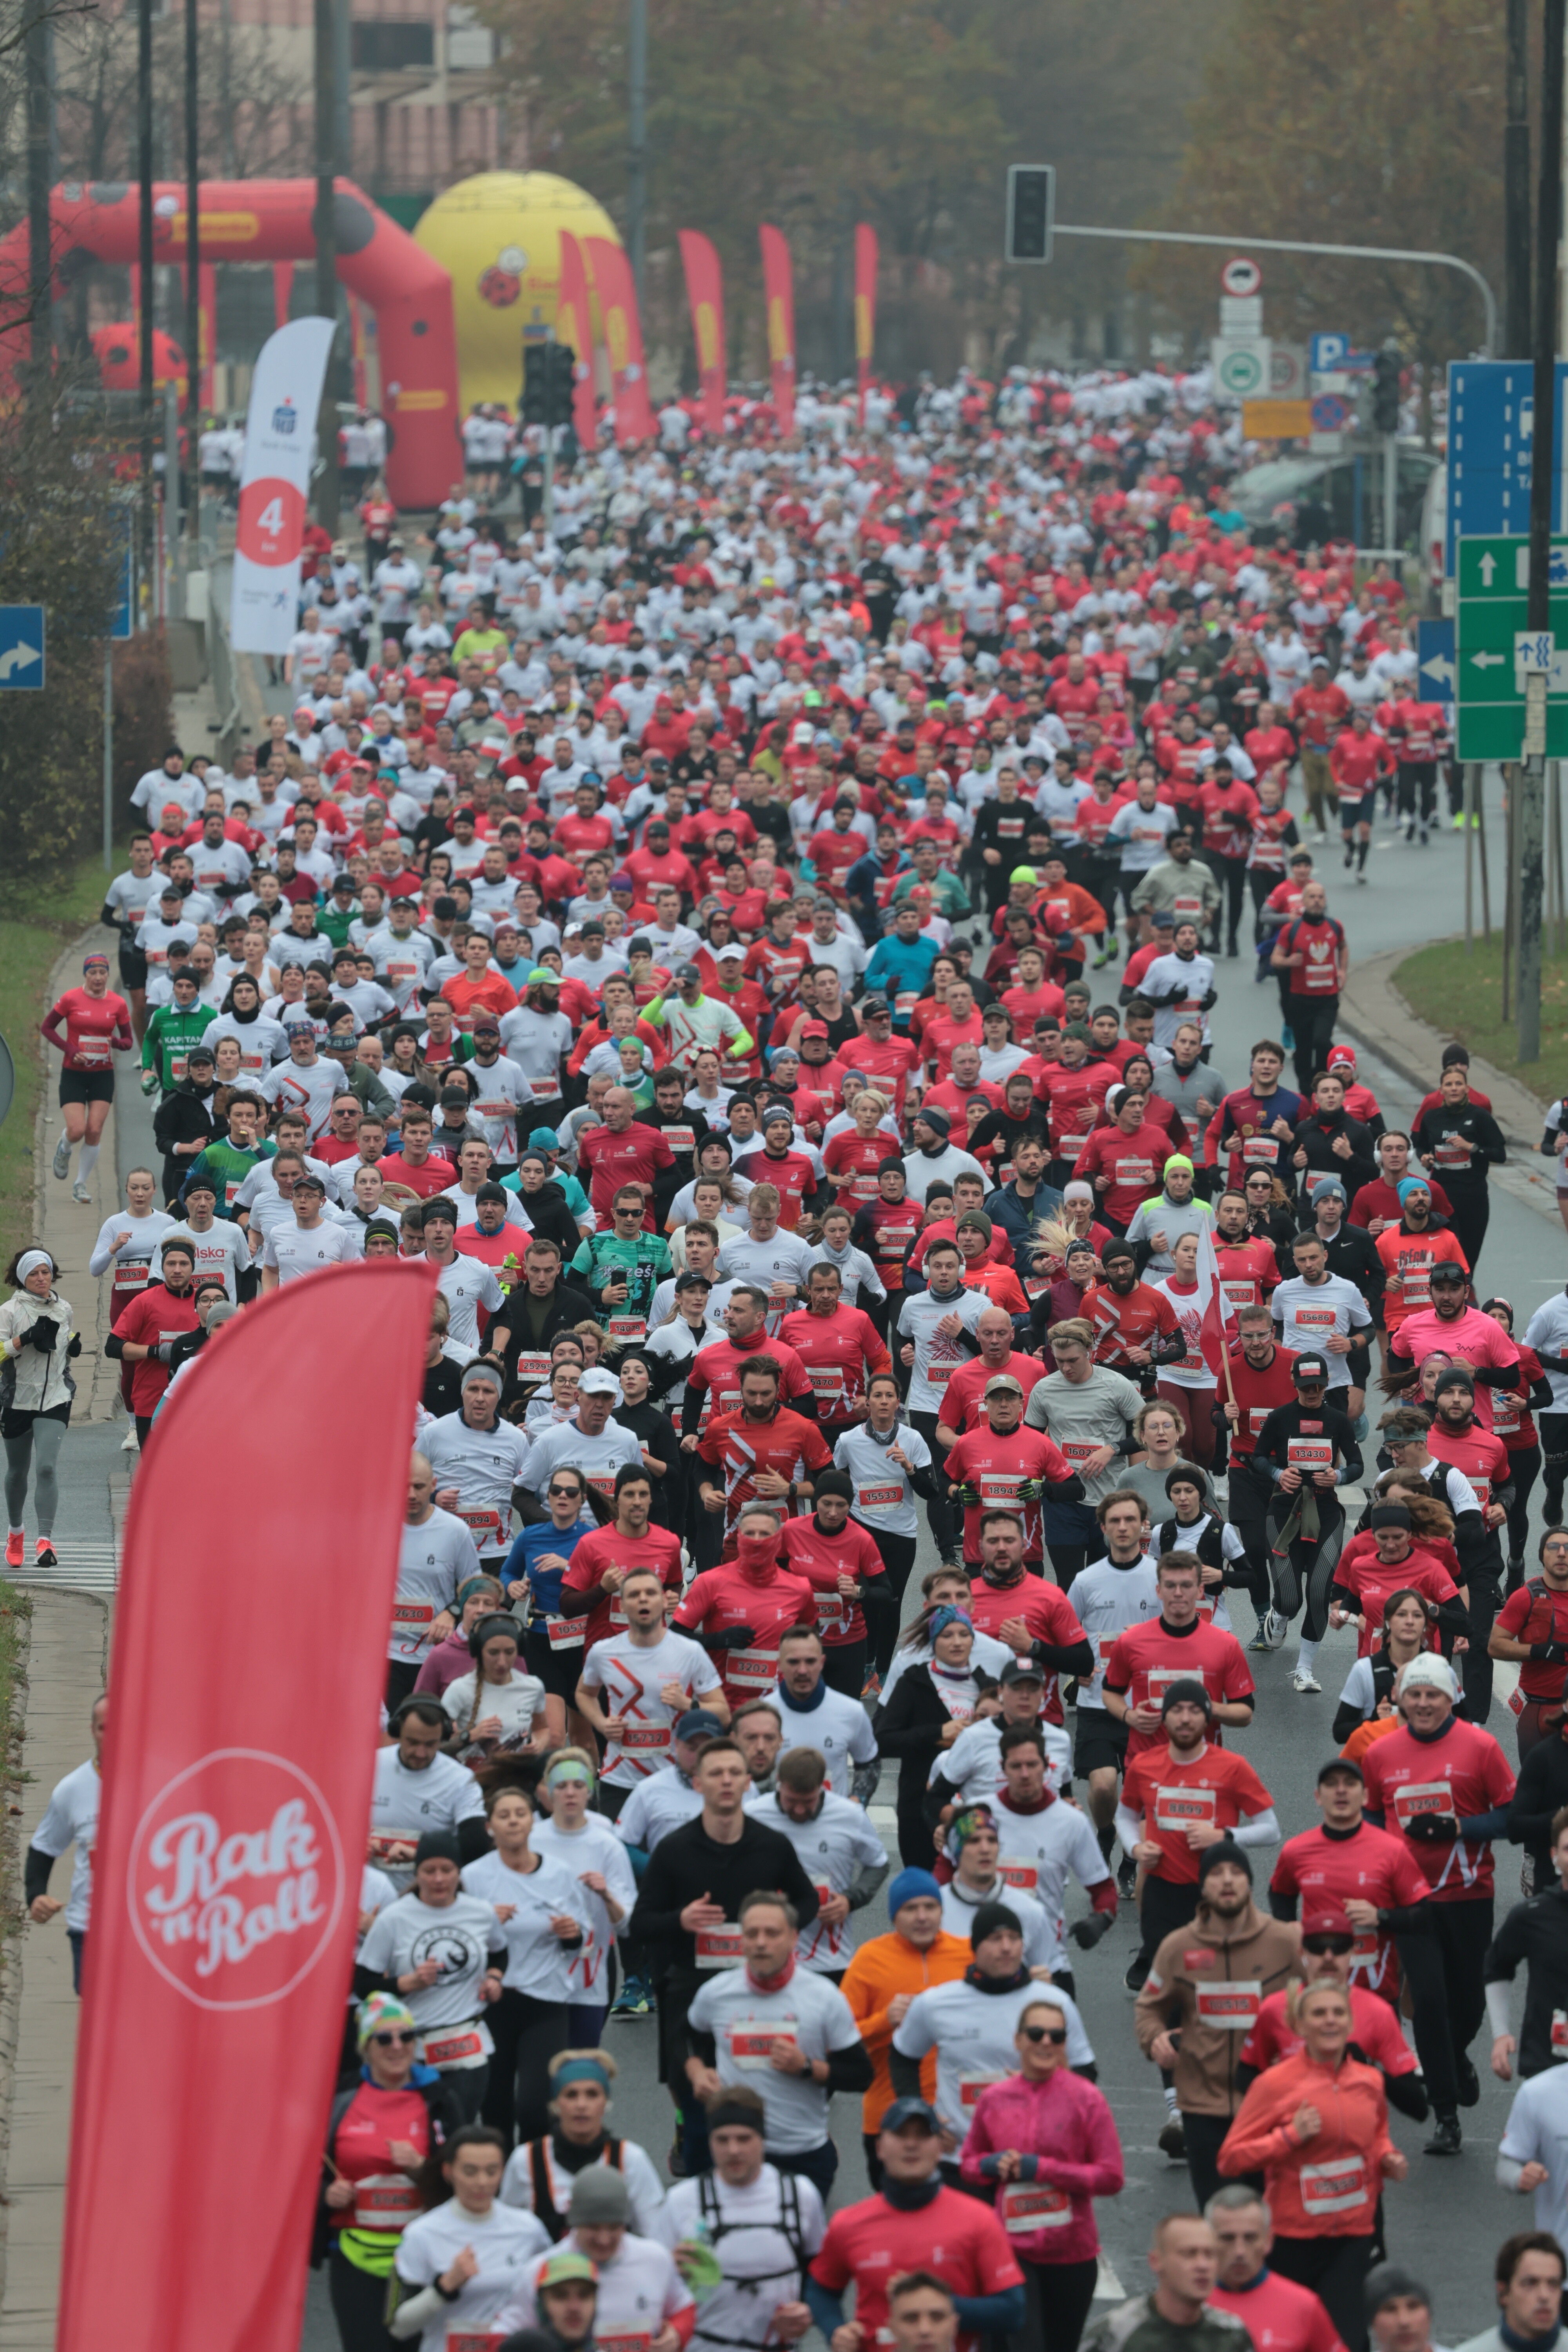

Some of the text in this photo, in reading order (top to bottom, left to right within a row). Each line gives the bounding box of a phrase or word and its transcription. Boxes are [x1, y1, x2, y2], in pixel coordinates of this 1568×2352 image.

[257, 496, 285, 536] 4
[120, 1271, 142, 1279] 11397
[523, 1362, 552, 1371] 25295
[867, 1491, 897, 1501] 15533
[394, 1609, 423, 1618] 2630
[738, 1662, 767, 1673] 3202
[628, 1733, 662, 1743] 15732
[144, 1797, 321, 1913] Rak
[196, 1869, 326, 1977] Roll
